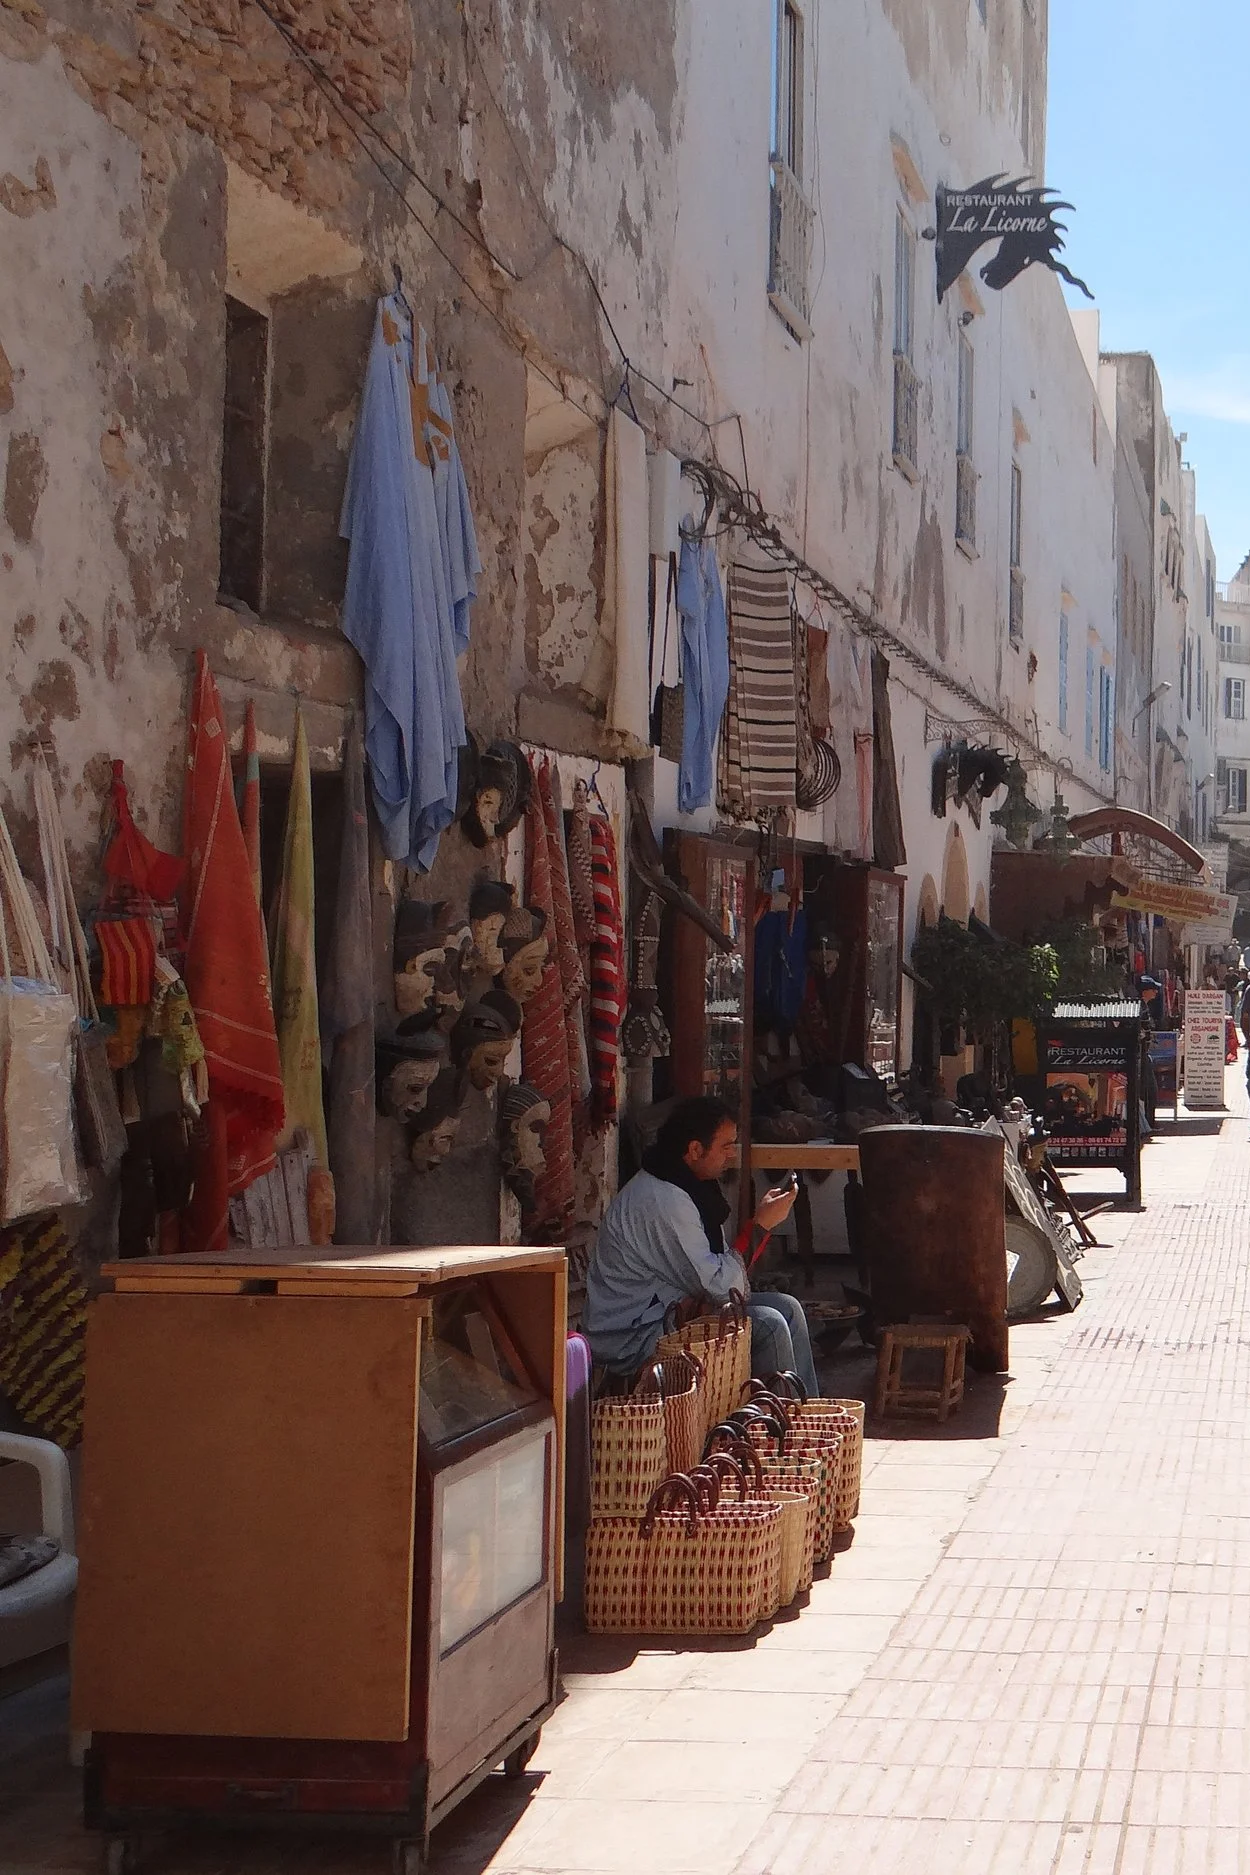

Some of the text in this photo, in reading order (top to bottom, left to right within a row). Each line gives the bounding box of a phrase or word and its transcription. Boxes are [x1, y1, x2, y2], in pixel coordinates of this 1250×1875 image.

[946, 194, 1034, 207] RESTAURANT
[946, 206, 1048, 233] La Licorne
[1051, 1047, 1127, 1056] RESTAURANT
[1051, 1055, 1128, 1065] La Licorne
